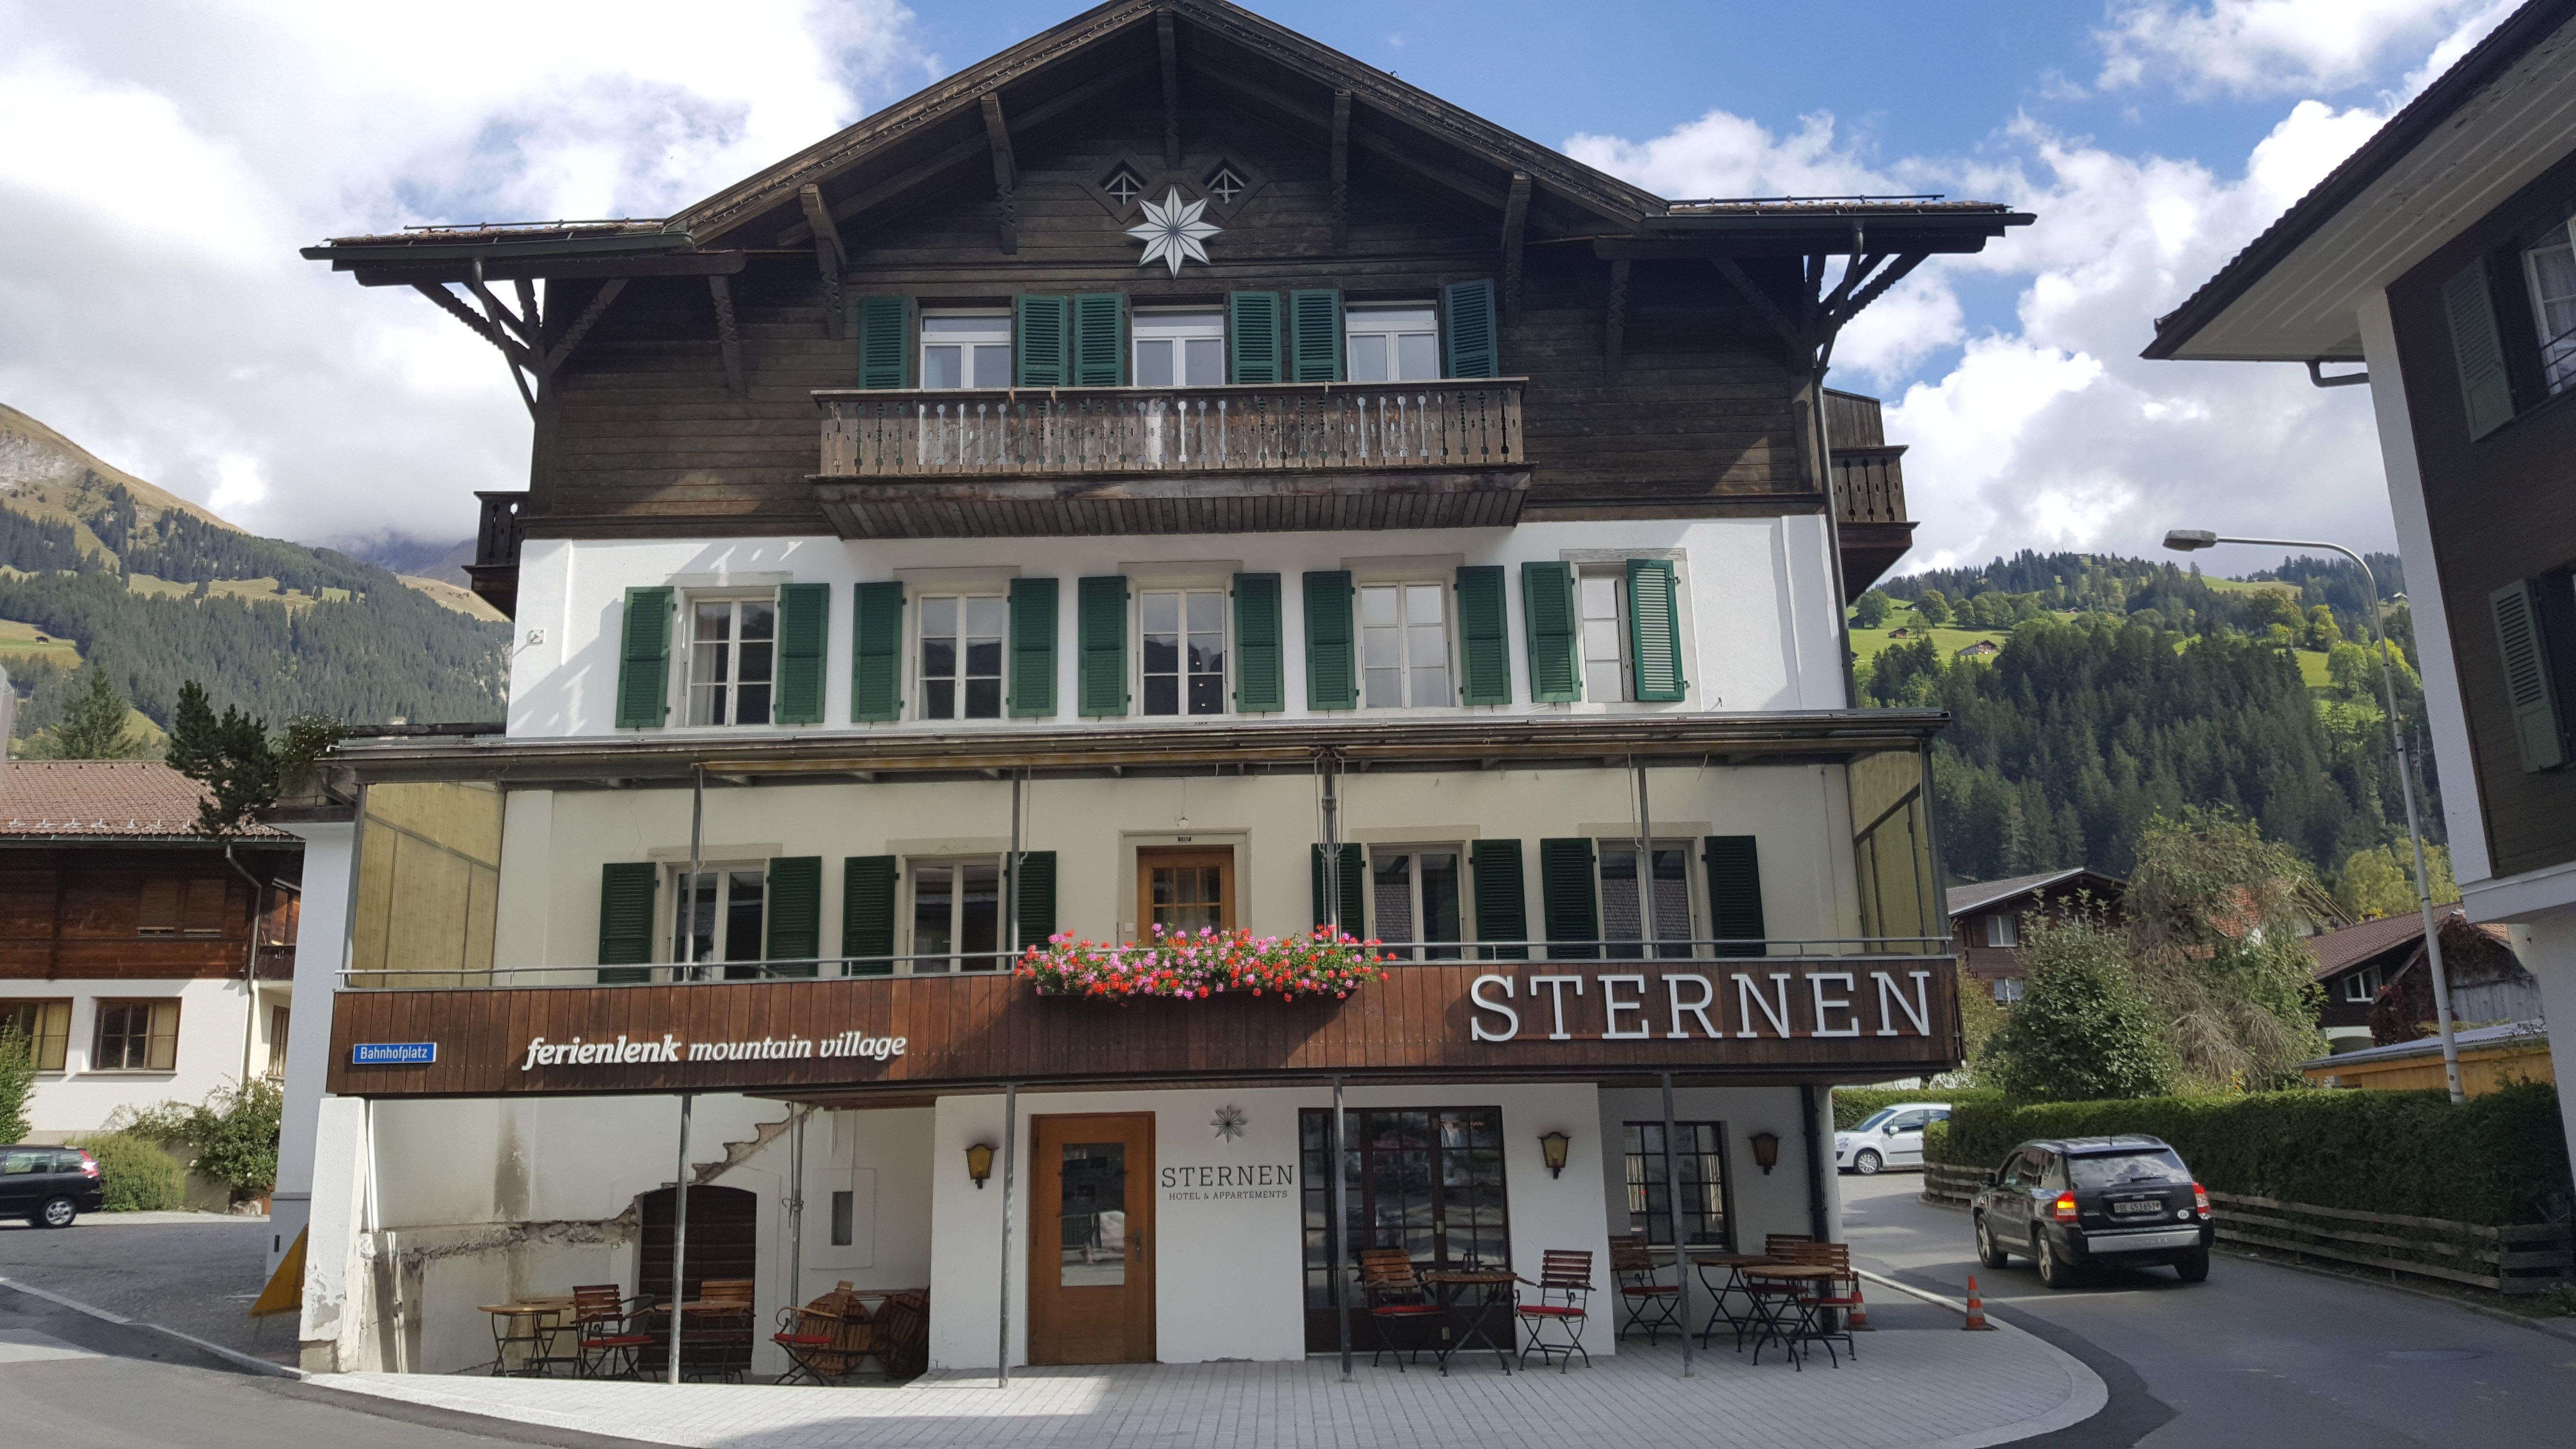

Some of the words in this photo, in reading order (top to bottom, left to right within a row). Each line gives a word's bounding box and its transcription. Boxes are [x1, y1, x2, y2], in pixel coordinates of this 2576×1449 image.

[1470, 971, 1930, 1042] STERNEN
[360, 1046, 427, 1062] Bahnhofplatz
[521, 1033, 681, 1071] ferienlenk
[688, 1033, 811, 1061] mountain
[820, 1030, 906, 1061] village
[1162, 1165, 1293, 1188] STERNEN
[1169, 1192, 1200, 1200] HOTEL
[1213, 1190, 1288, 1200] APPARTEMENTS
